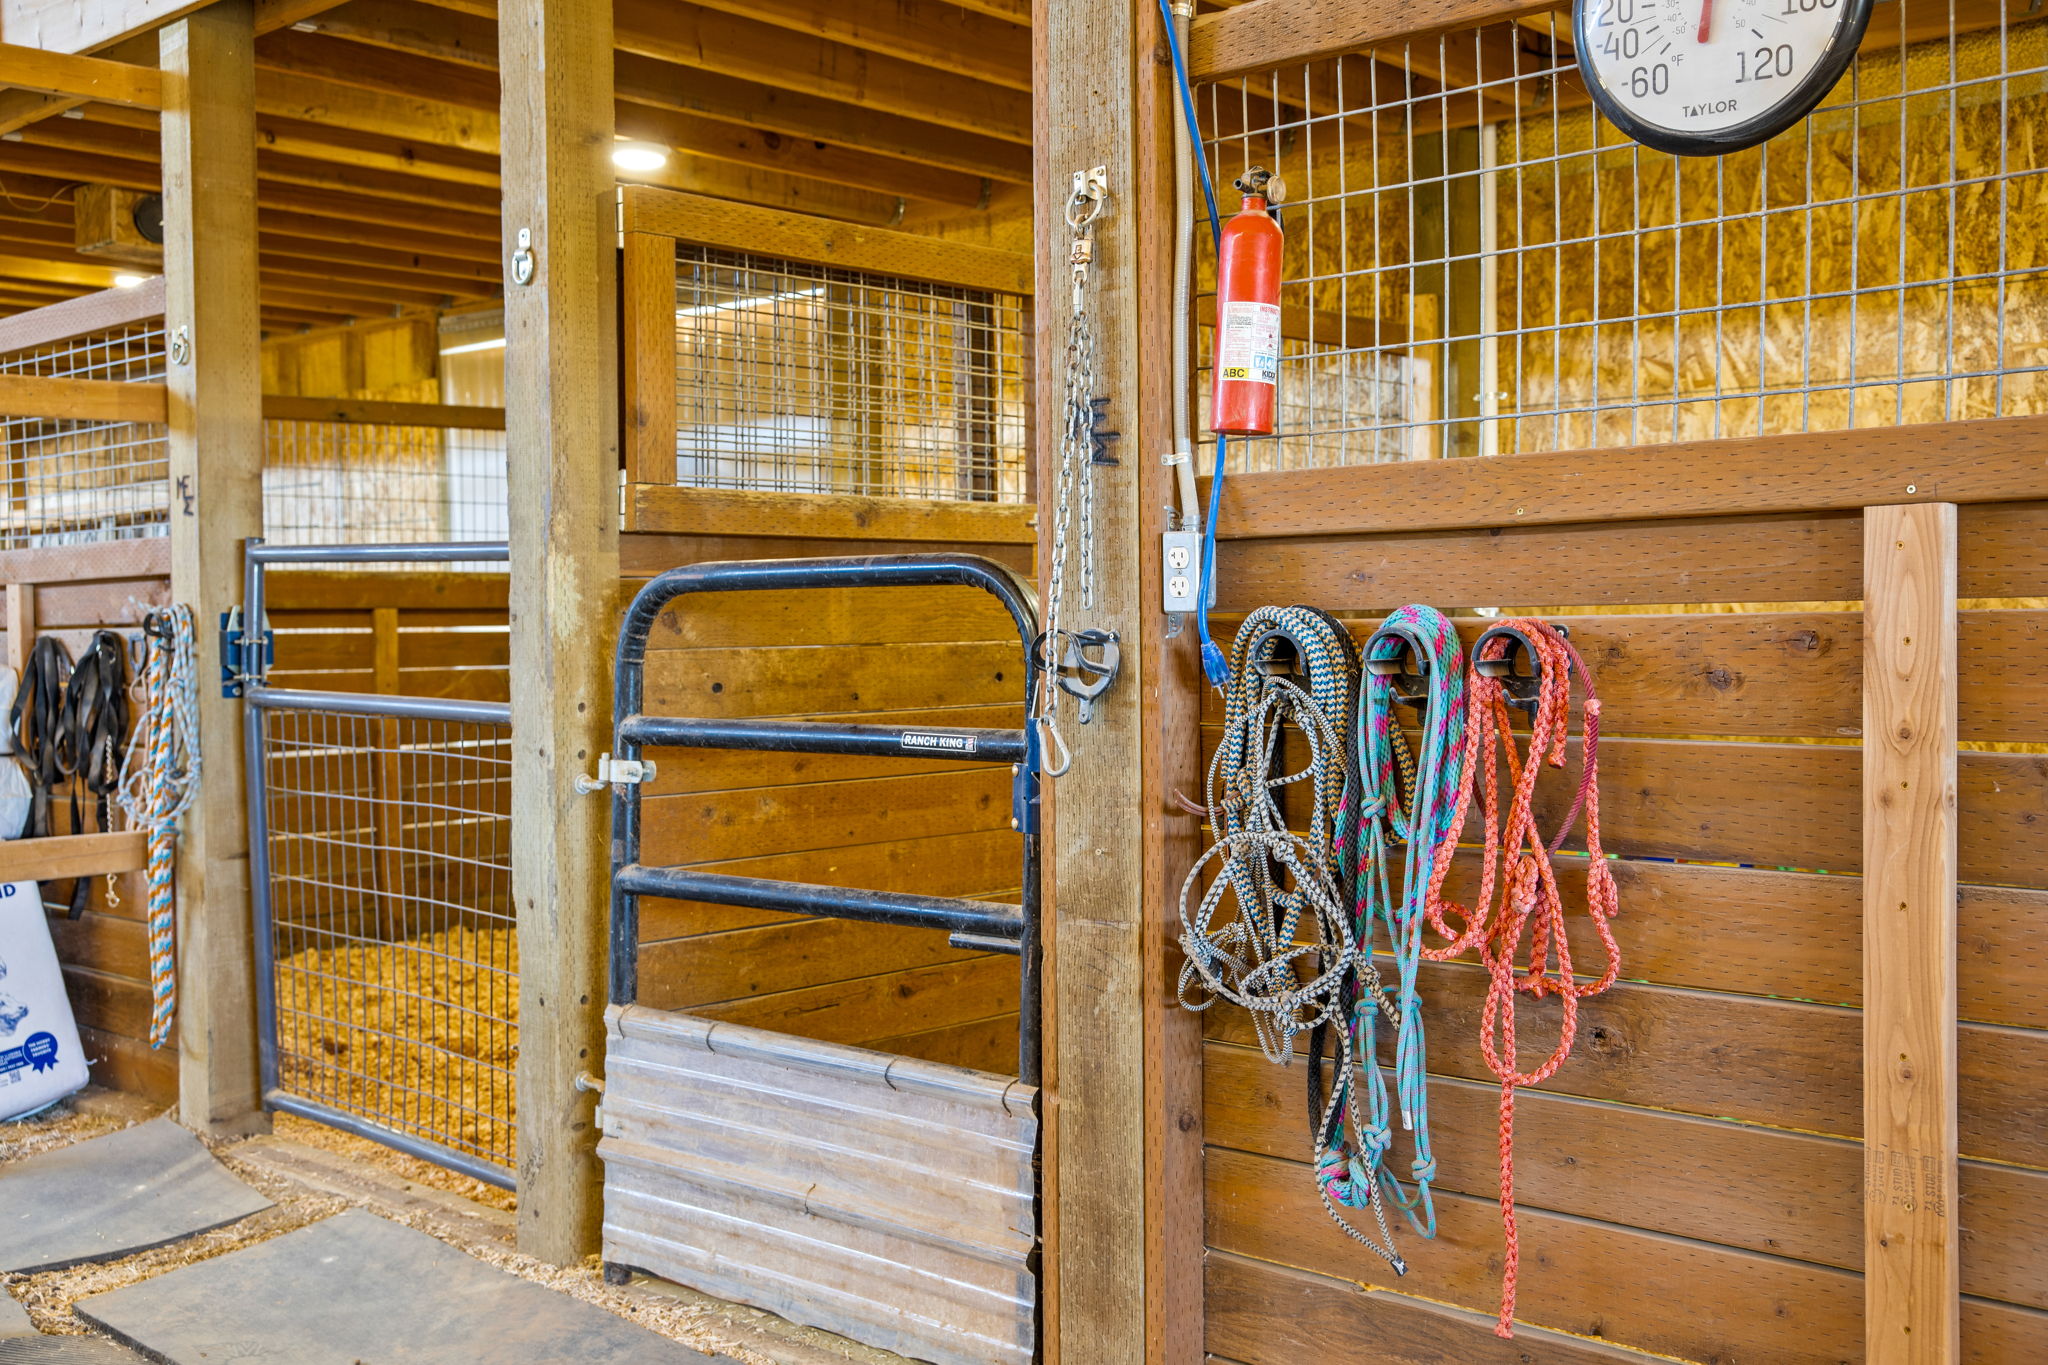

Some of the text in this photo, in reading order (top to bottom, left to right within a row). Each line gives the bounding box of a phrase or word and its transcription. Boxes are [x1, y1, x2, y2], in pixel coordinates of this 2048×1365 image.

[1596, 28, 1639, 60] -40
[1736, 44, 1794, 84] 120
[1621, 63, 1669, 98] -60
[1682, 100, 1738, 118] TAYLOR
[1223, 368, 1245, 378] ABC
[904, 735, 963, 748] RANCH KING
